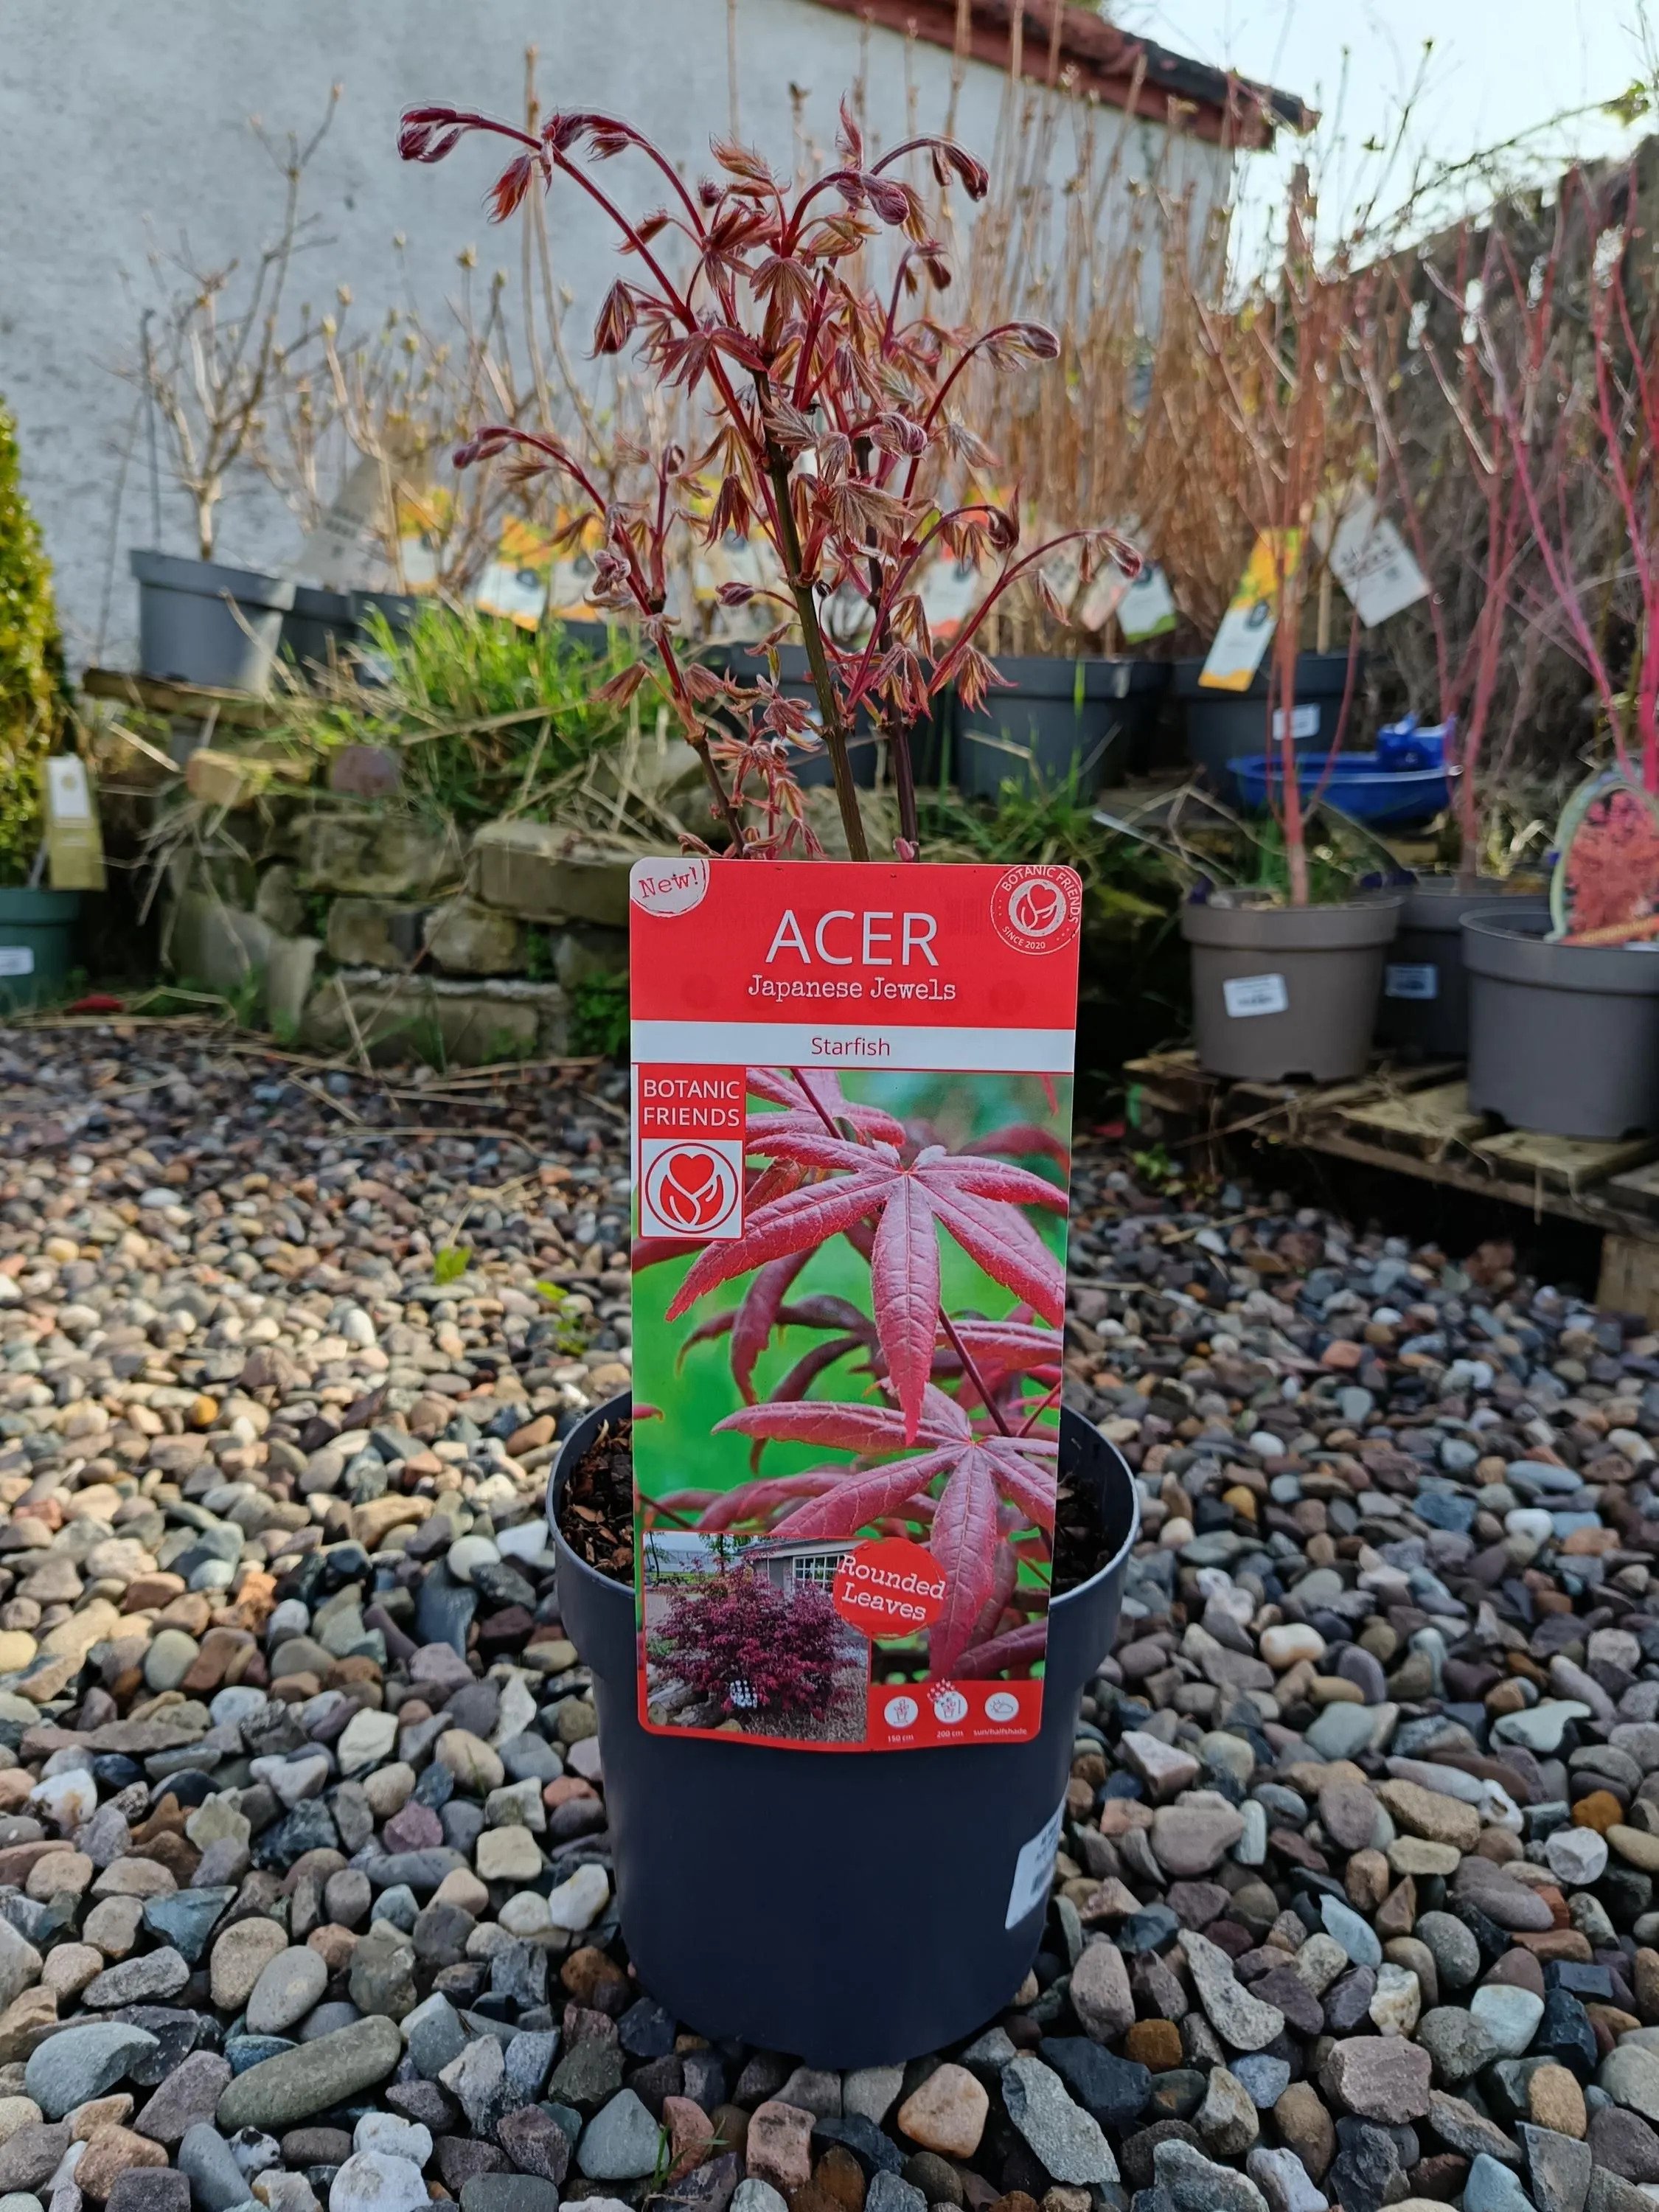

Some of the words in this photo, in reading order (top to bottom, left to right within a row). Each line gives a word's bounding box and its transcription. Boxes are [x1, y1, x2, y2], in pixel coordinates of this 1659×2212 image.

[639, 866, 700, 898] New!
[1001, 866, 1056, 891] BOTANIC
[1056, 872, 1081, 924] FRIENDS
[765, 909, 939, 966] ACER
[1003, 926, 1024, 946] SINCE
[1025, 941, 1046, 950] 2020
[748, 974, 863, 1002] Japanese
[870, 977, 956, 1001] Jewels
[811, 1037, 891, 1057] Starfish
[643, 1079, 740, 1099] BOTANIC
[643, 1107, 740, 1127] FRIENDS
[837, 1554, 946, 1600] Rounded
[841, 1582, 926, 1621] Leaves
[936, 1731, 950, 1739] 200
